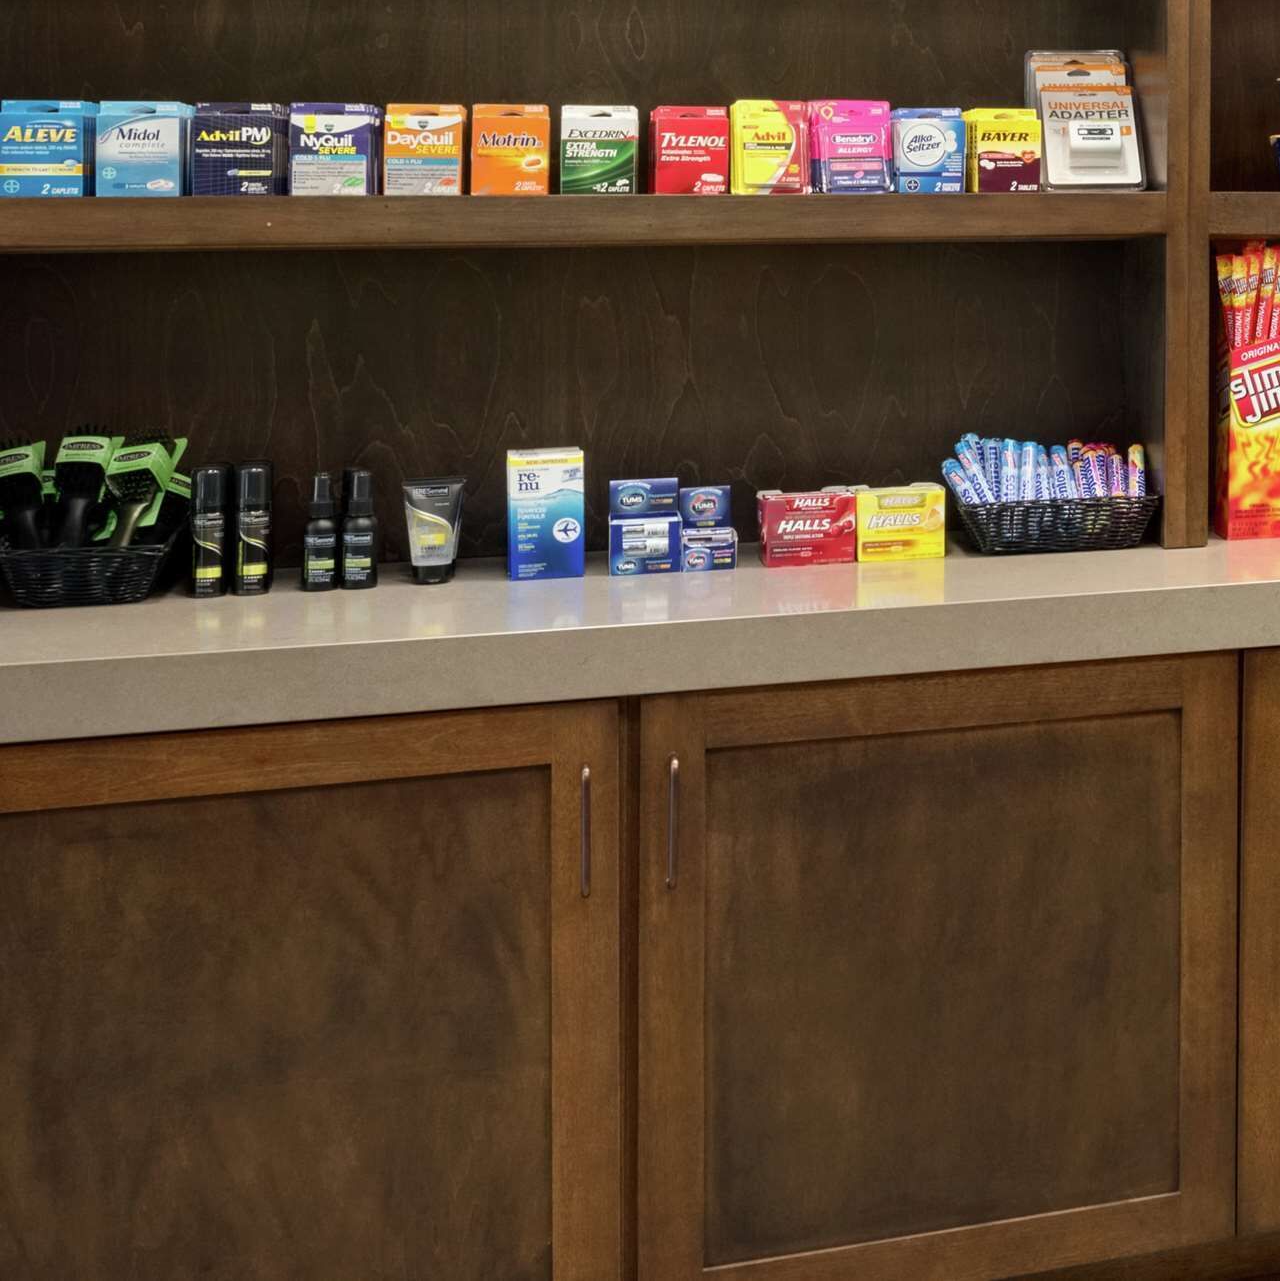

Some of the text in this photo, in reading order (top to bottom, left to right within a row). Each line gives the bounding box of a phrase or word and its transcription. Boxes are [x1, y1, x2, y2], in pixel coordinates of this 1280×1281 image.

[1048, 101, 1129, 111] UNIVERSAL
[1048, 110, 1129, 120] ADAPTER
[2, 125, 78, 143] ALEVE
[116, 126, 160, 141] Midol
[197, 126, 268, 143] Advil PM
[567, 129, 628, 139] EXCEDRIN
[751, 131, 786, 142] Advil
[981, 131, 1029, 142] BAYER
[300, 134, 353, 150] NyQuil
[386, 131, 454, 149] DayQuil
[479, 133, 537, 148] Motrin
[660, 132, 727, 148] TYLENOL
[833, 134, 874, 145] Benadryl
[910, 134, 936, 145] Alka-
[319, 146, 357, 155] SEVERE
[415, 145, 459, 155] SEVERE
[565, 142, 597, 151] EXTRA
[906, 142, 941, 154] Seltzer
[565, 148, 618, 158] STRENGTH
[41, 183, 50, 195] 2
[693, 181, 701, 192] 2
[1010, 181, 1017, 191] 2
[1255, 300, 1266, 338] ORIGINAL
[1234, 310, 1243, 348] ORIGINAL
[621, 495, 643, 504] TUMS
[793, 497, 831, 507] HALLS
[693, 501, 715, 510] TUMS
[777, 518, 831, 534] HALLS
[868, 513, 921, 529] HALLS
[688, 556, 704, 565] TUMS
[618, 563, 635, 571] TUMS
